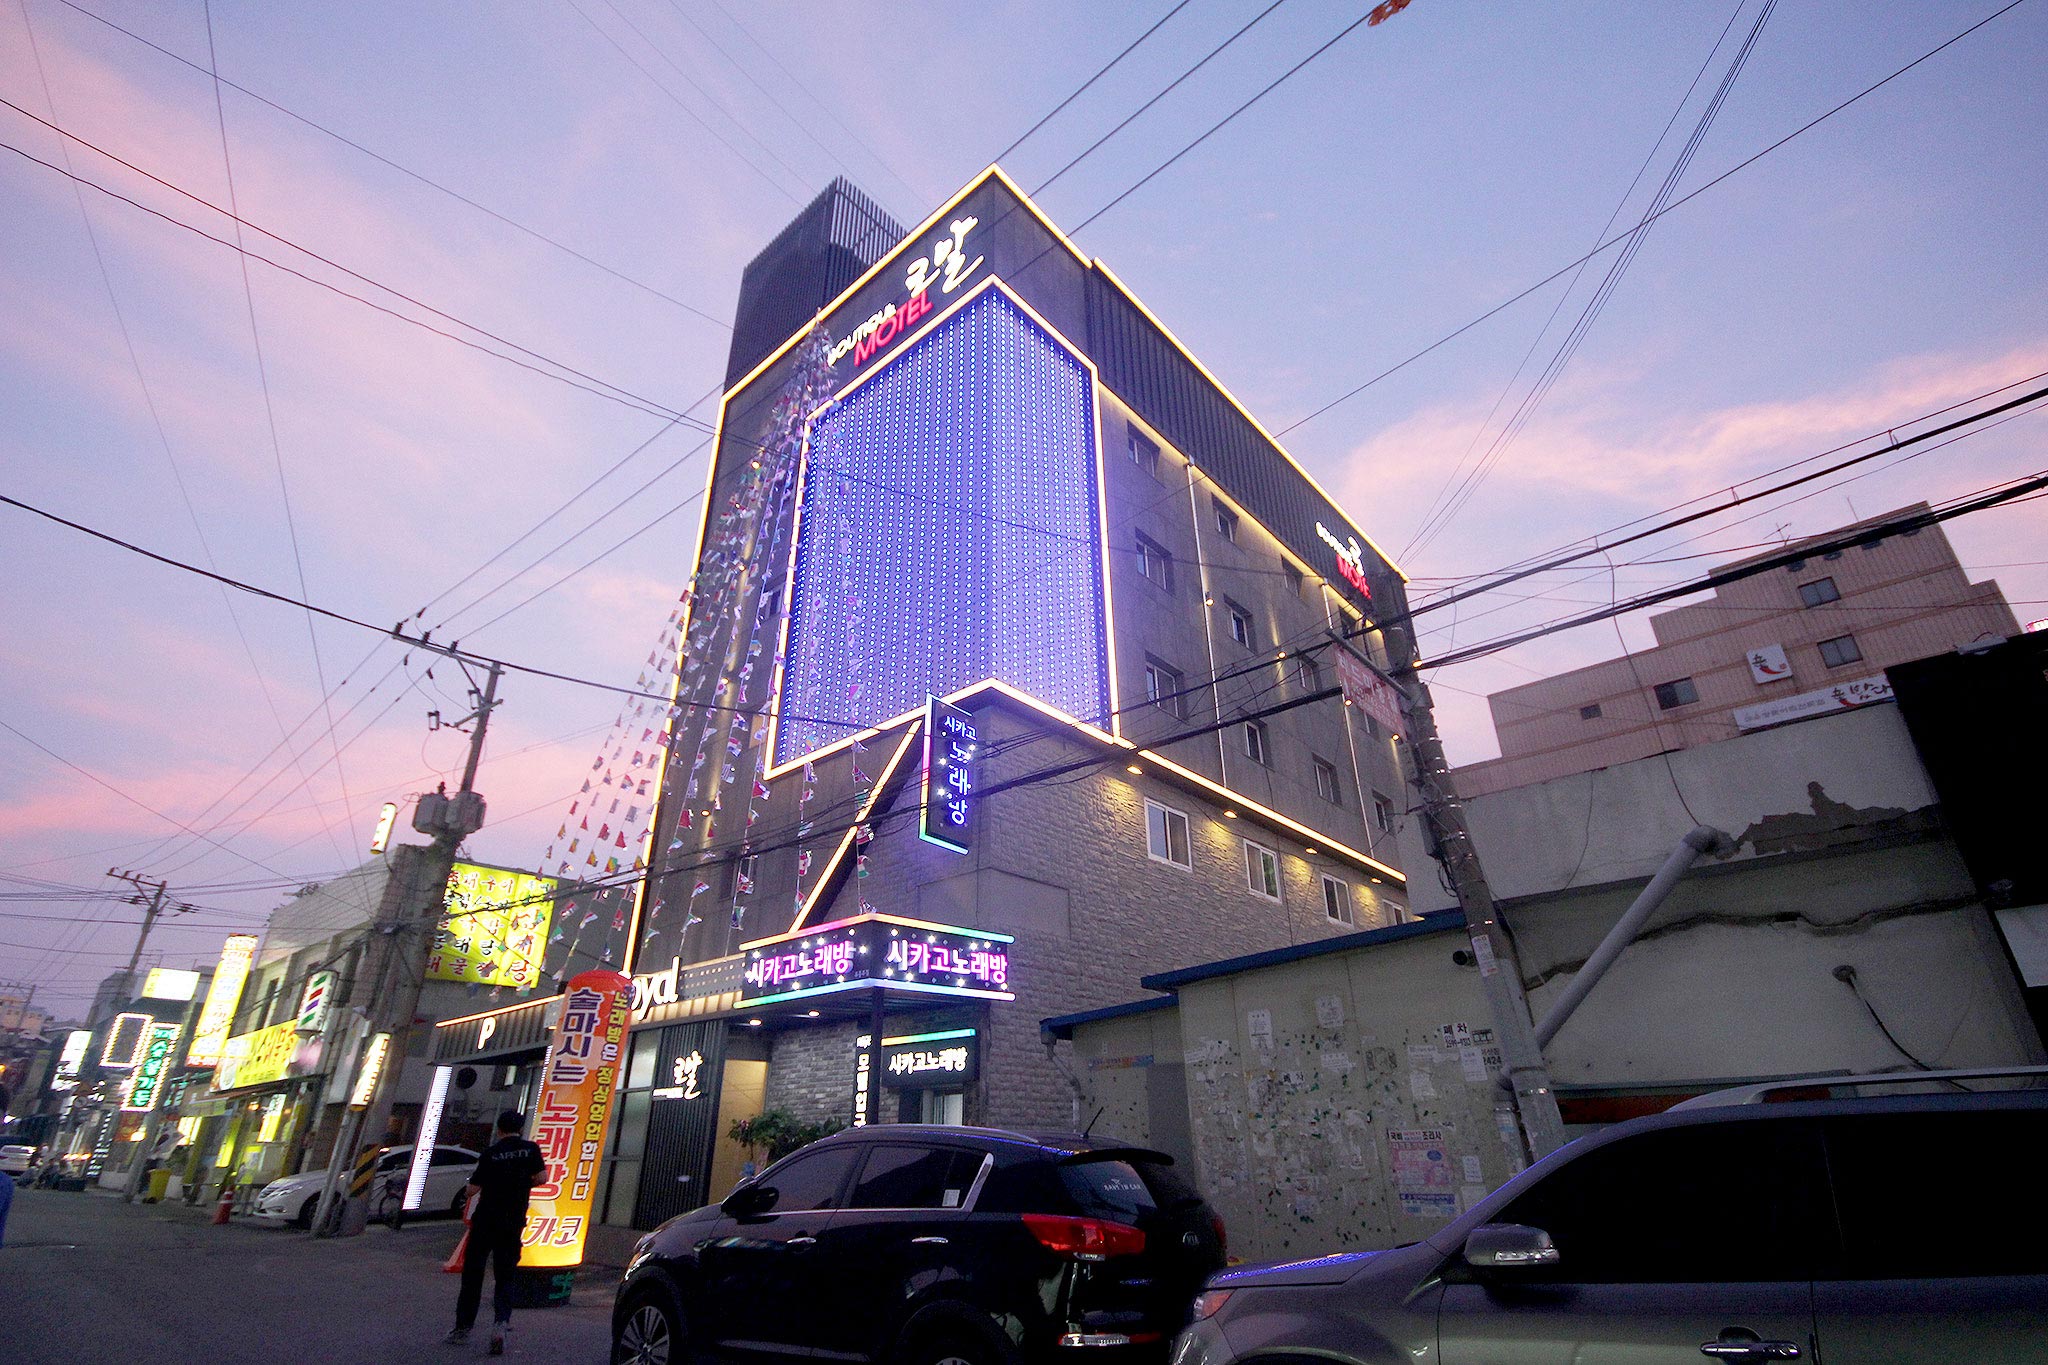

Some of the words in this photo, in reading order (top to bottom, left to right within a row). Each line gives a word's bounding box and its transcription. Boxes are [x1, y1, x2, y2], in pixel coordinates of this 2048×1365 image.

[853, 289, 934, 367] MOTEL
[944, 715, 978, 741] 시카고
[948, 741, 970, 826] 노래방
[748, 940, 853, 987] 시카고노래방
[887, 939, 1008, 984] 시카고노래방
[551, 986, 604, 1085] 술마시는
[888, 1047, 968, 1075] 시카고노래방
[528, 1090, 579, 1200] 노래방
[571, 1065, 614, 1201] 정상영업합니다
[521, 1215, 583, 1247] 카코
